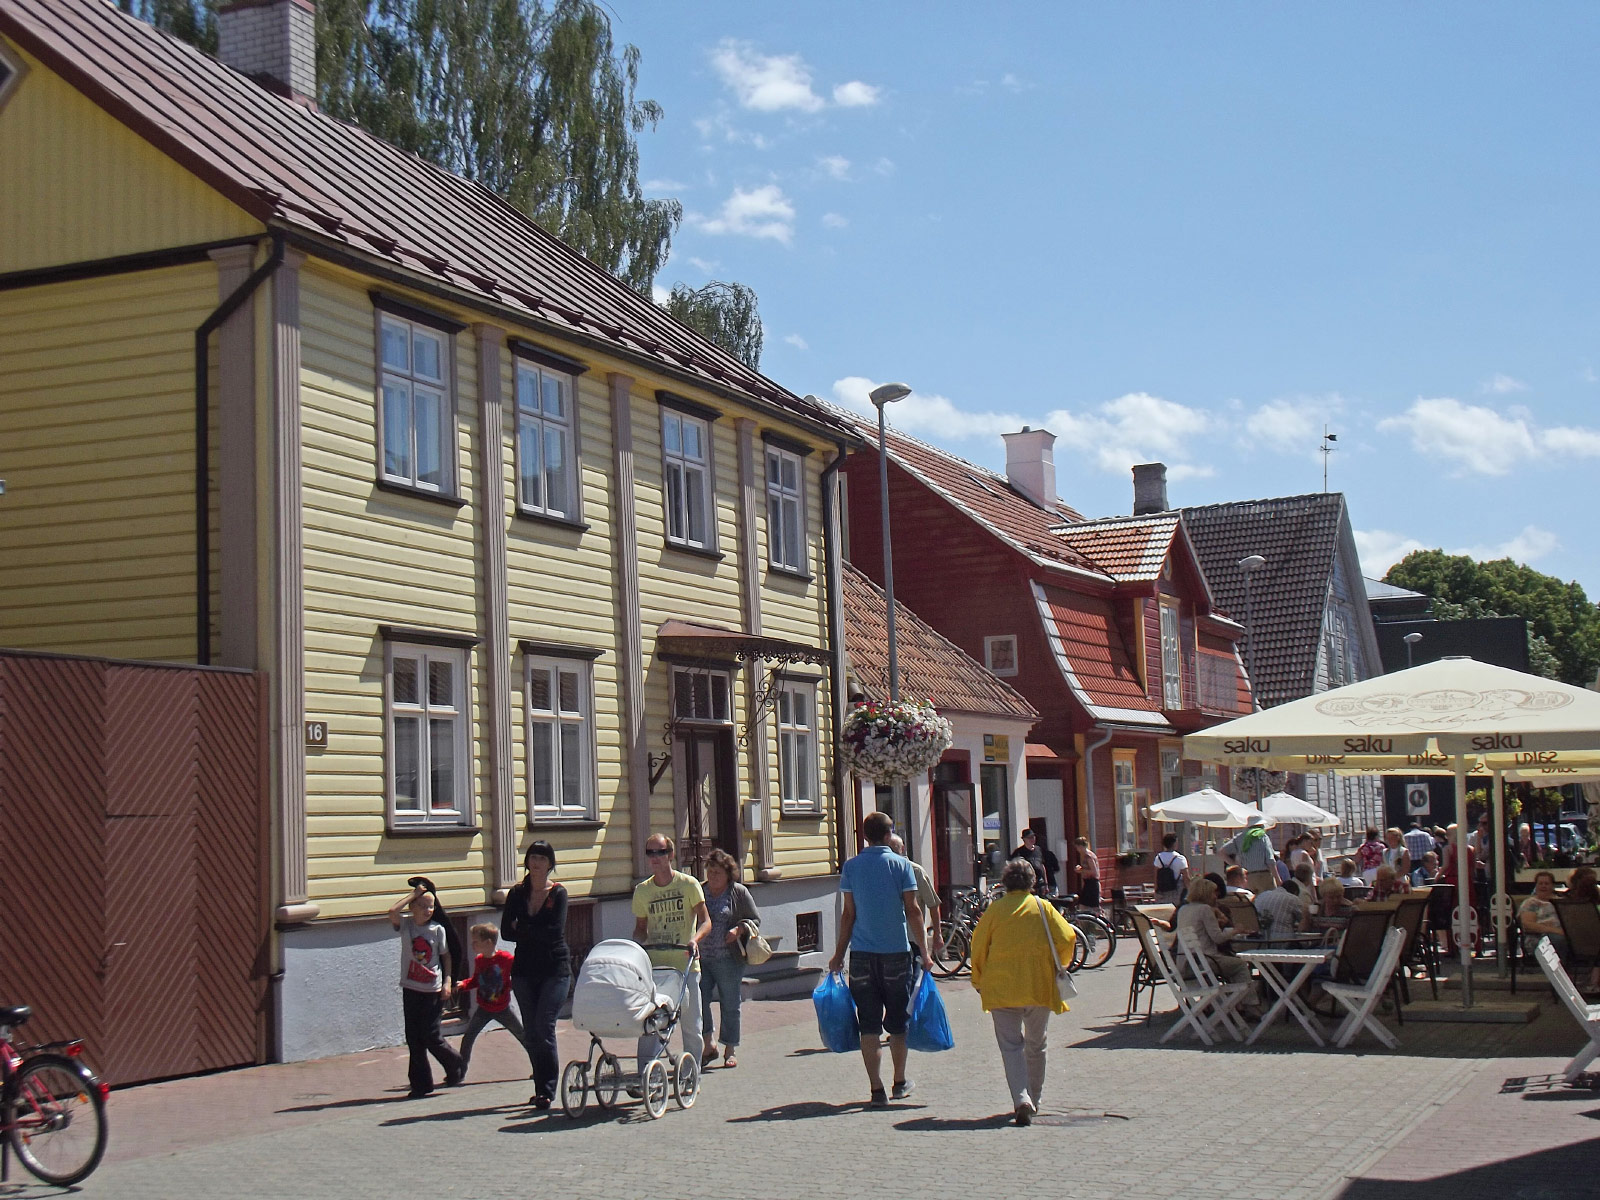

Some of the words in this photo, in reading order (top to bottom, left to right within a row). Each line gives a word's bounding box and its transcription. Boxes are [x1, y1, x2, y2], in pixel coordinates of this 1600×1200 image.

[308, 724, 323, 741] 16
[1471, 732, 1522, 751] saku
[1223, 736, 1270, 754] saku
[1343, 735, 1393, 753] saku
